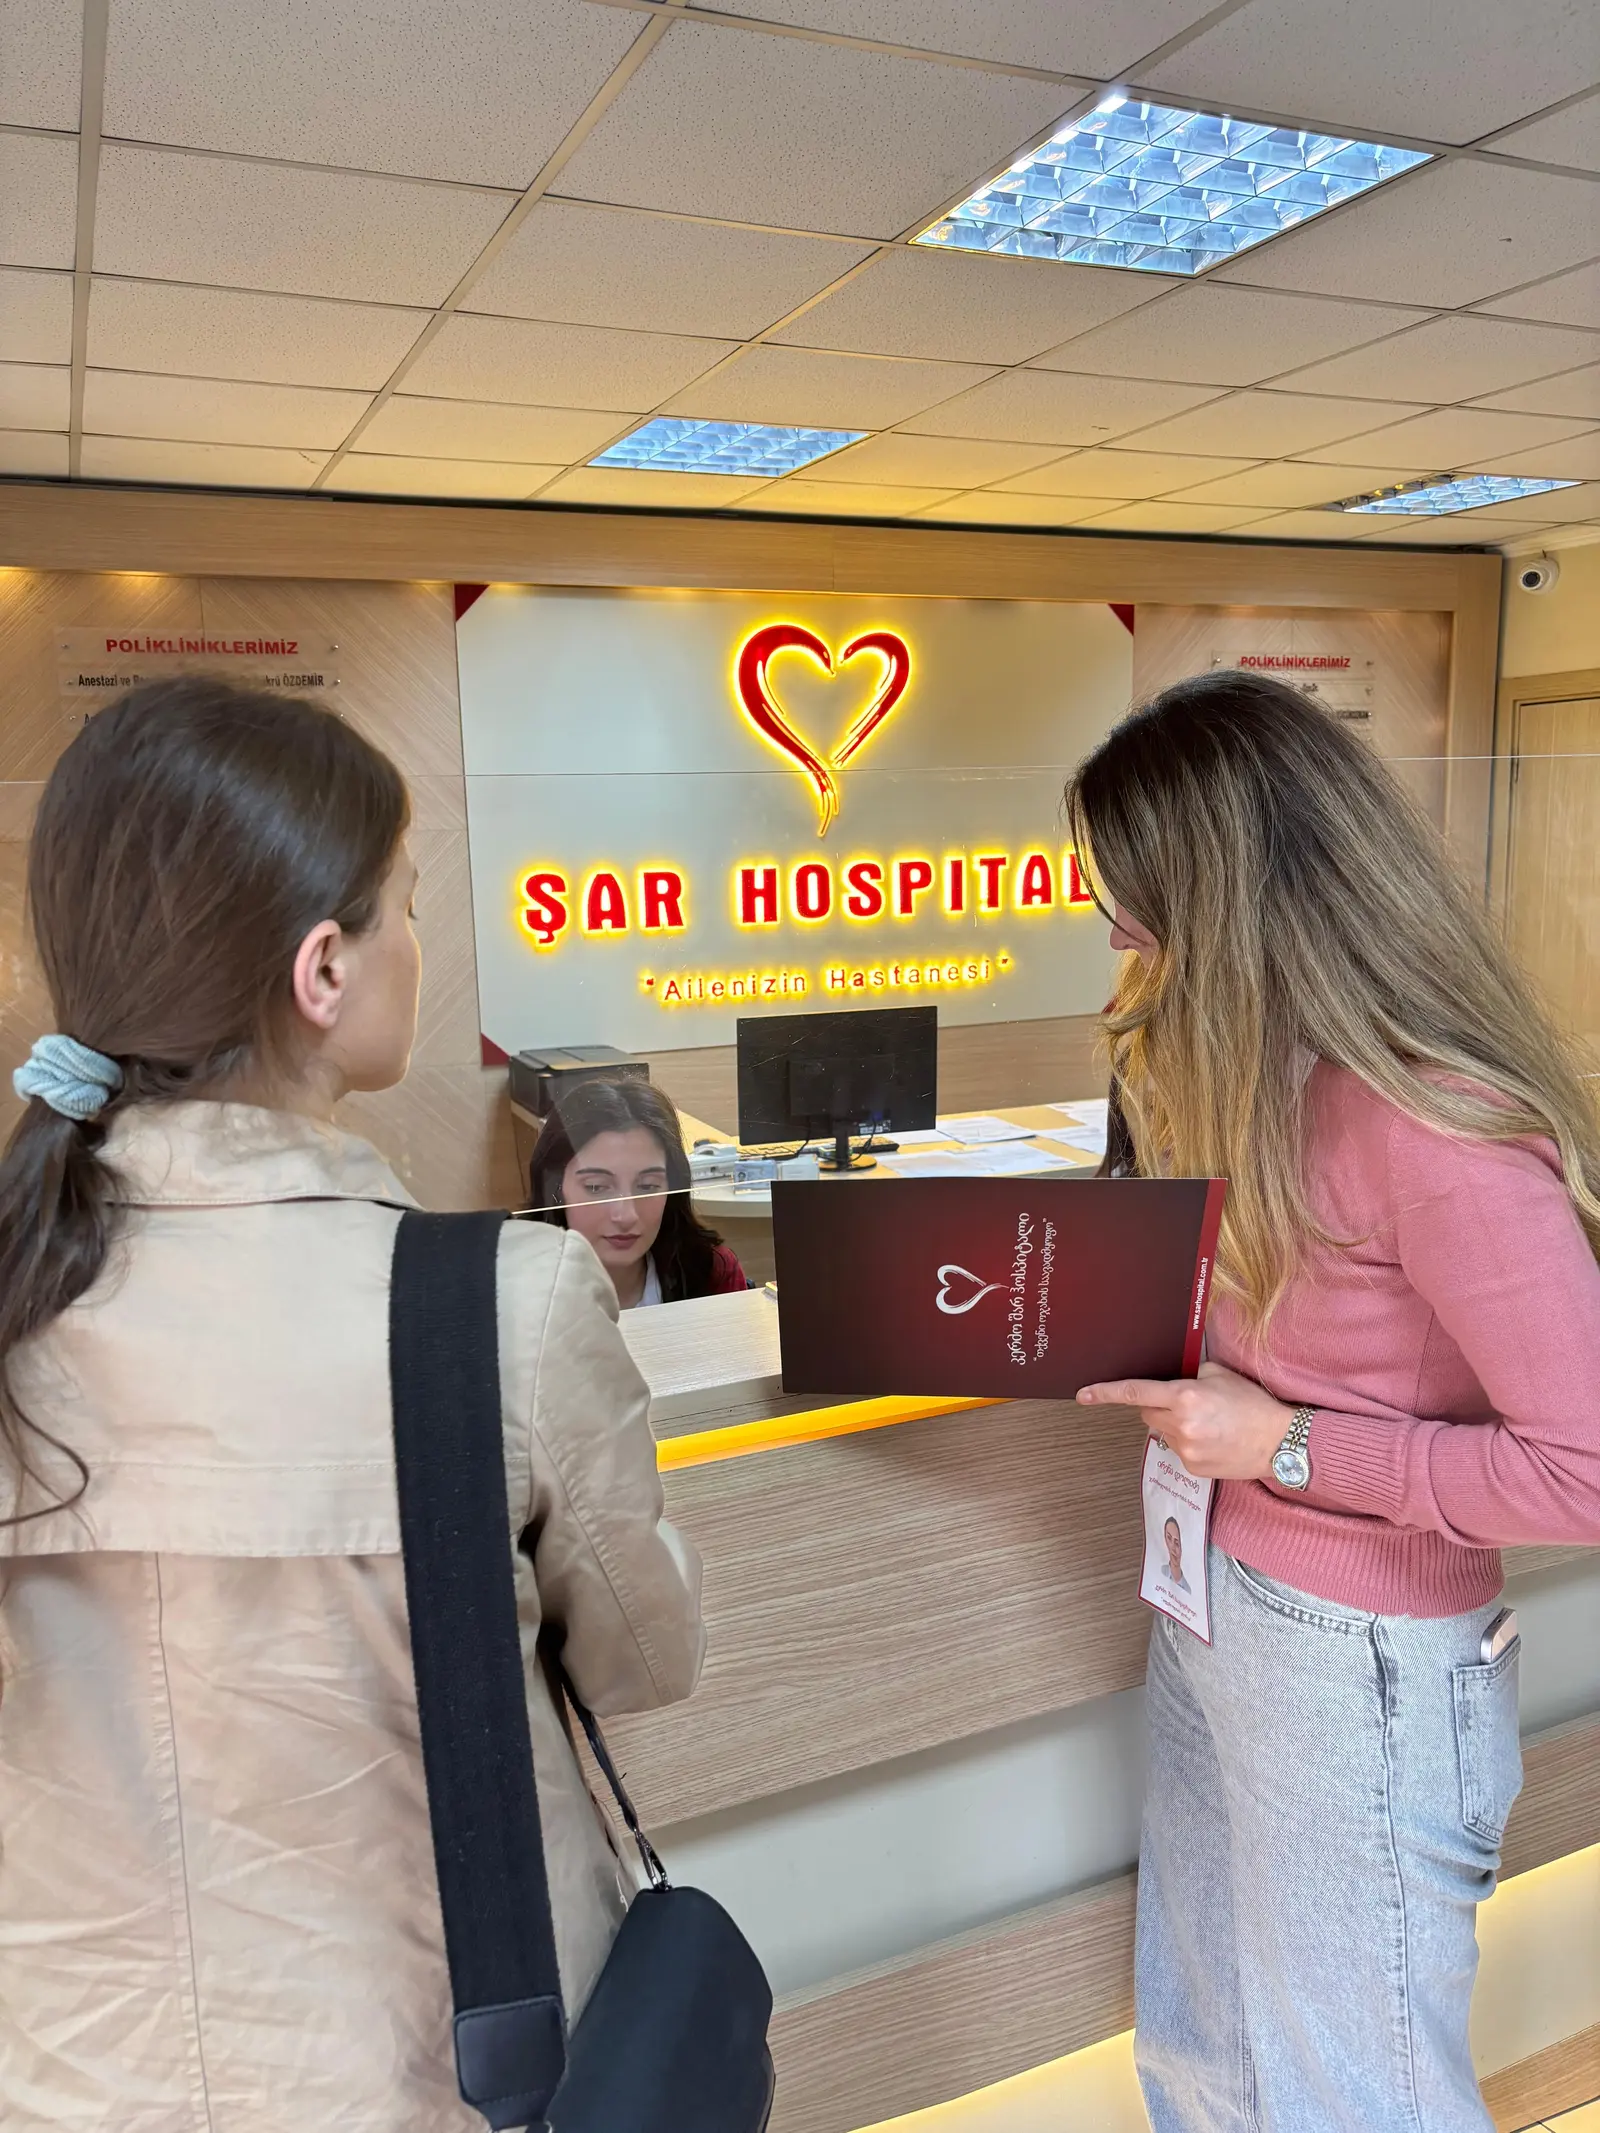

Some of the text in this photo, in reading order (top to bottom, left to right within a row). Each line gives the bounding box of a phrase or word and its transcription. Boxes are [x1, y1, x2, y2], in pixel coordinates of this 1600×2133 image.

[105, 636, 299, 655] POLİKLİNİKLERİMİZ
[1240, 654, 1351, 669] POLİKLİNİKLERİMİZ
[78, 673, 118, 687] Anestezi
[120, 675, 131, 687] ve
[282, 672, 324, 687] ÖZDEMİR
[525, 853, 1093, 944] ŞAR HOSPITAL
[1006, 1212, 1035, 1366] კერძო შარ ჰოსპიტალი
[1036, 1287, 1051, 1323] ოჯახის
[1192, 1256, 1209, 1330] www.sarhospital.com.tr
